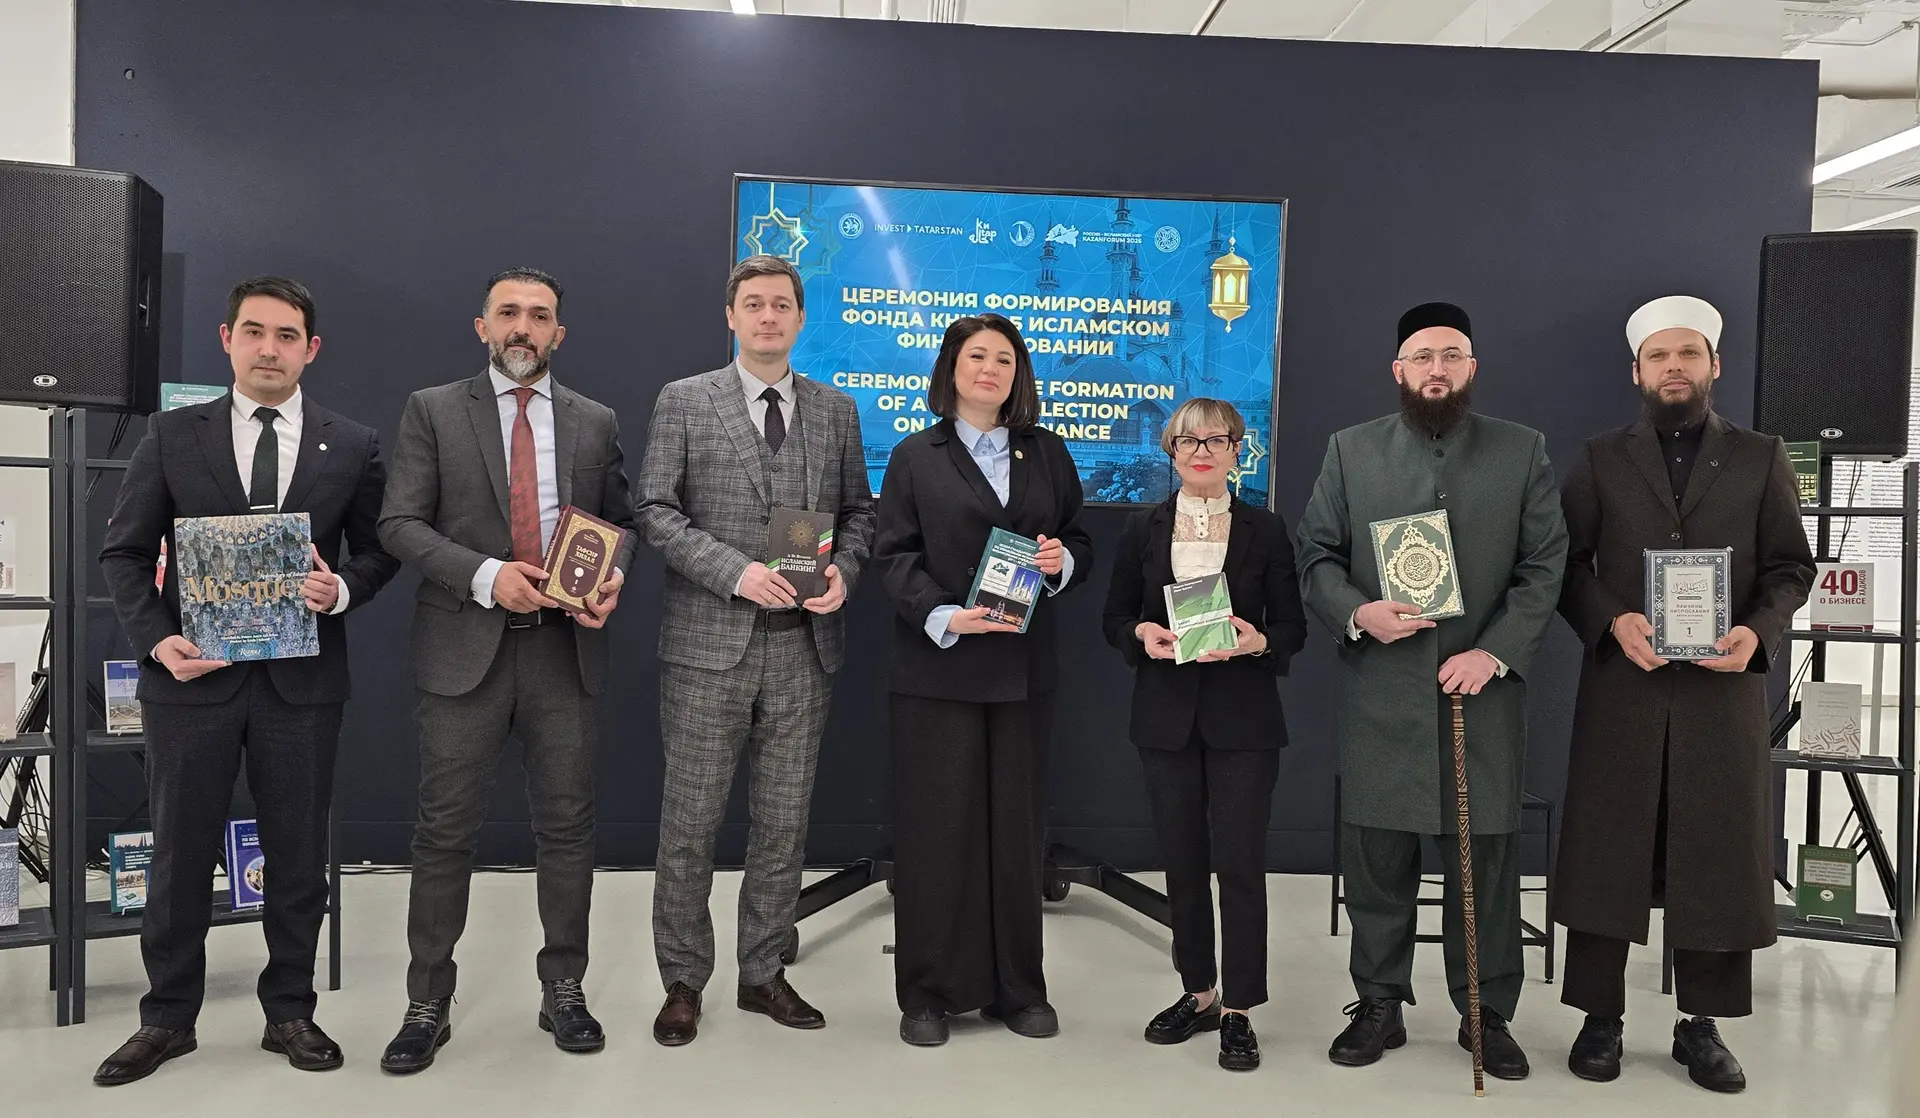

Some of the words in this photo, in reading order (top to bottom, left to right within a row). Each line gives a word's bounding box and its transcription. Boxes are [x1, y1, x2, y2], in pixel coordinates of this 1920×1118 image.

[875, 224, 905, 233] INVEST
[914, 225, 963, 236] TATARSTAN
[1082, 236, 1125, 244] KAZANFORUM
[842, 287, 978, 308] ЦЕРЕМОНИЯ
[983, 292, 1171, 316] ФОРМИРОВАНИЯ
[842, 308, 925, 329] ФОНДА
[1029, 316, 1170, 337] ИСЛАМСКОМ
[1049, 380, 1175, 400] FORMATION
[877, 394, 907, 411] OF
[911, 396, 927, 412] A
[1039, 401, 1128, 420] LECTION
[893, 416, 925, 433] ON
[576, 544, 599, 558] ТАФСИР
[780, 557, 817, 567] ИСЛАМСКИЙ
[780, 563, 817, 573] БАНКИНГ
[1820, 569, 1858, 596] 40
[1858, 569, 1867, 596] ХАДИСОВ
[1819, 597, 1826, 605] О
[1828, 597, 1867, 605] БИЗНЕСЕ
[1686, 626, 1692, 635] 1
